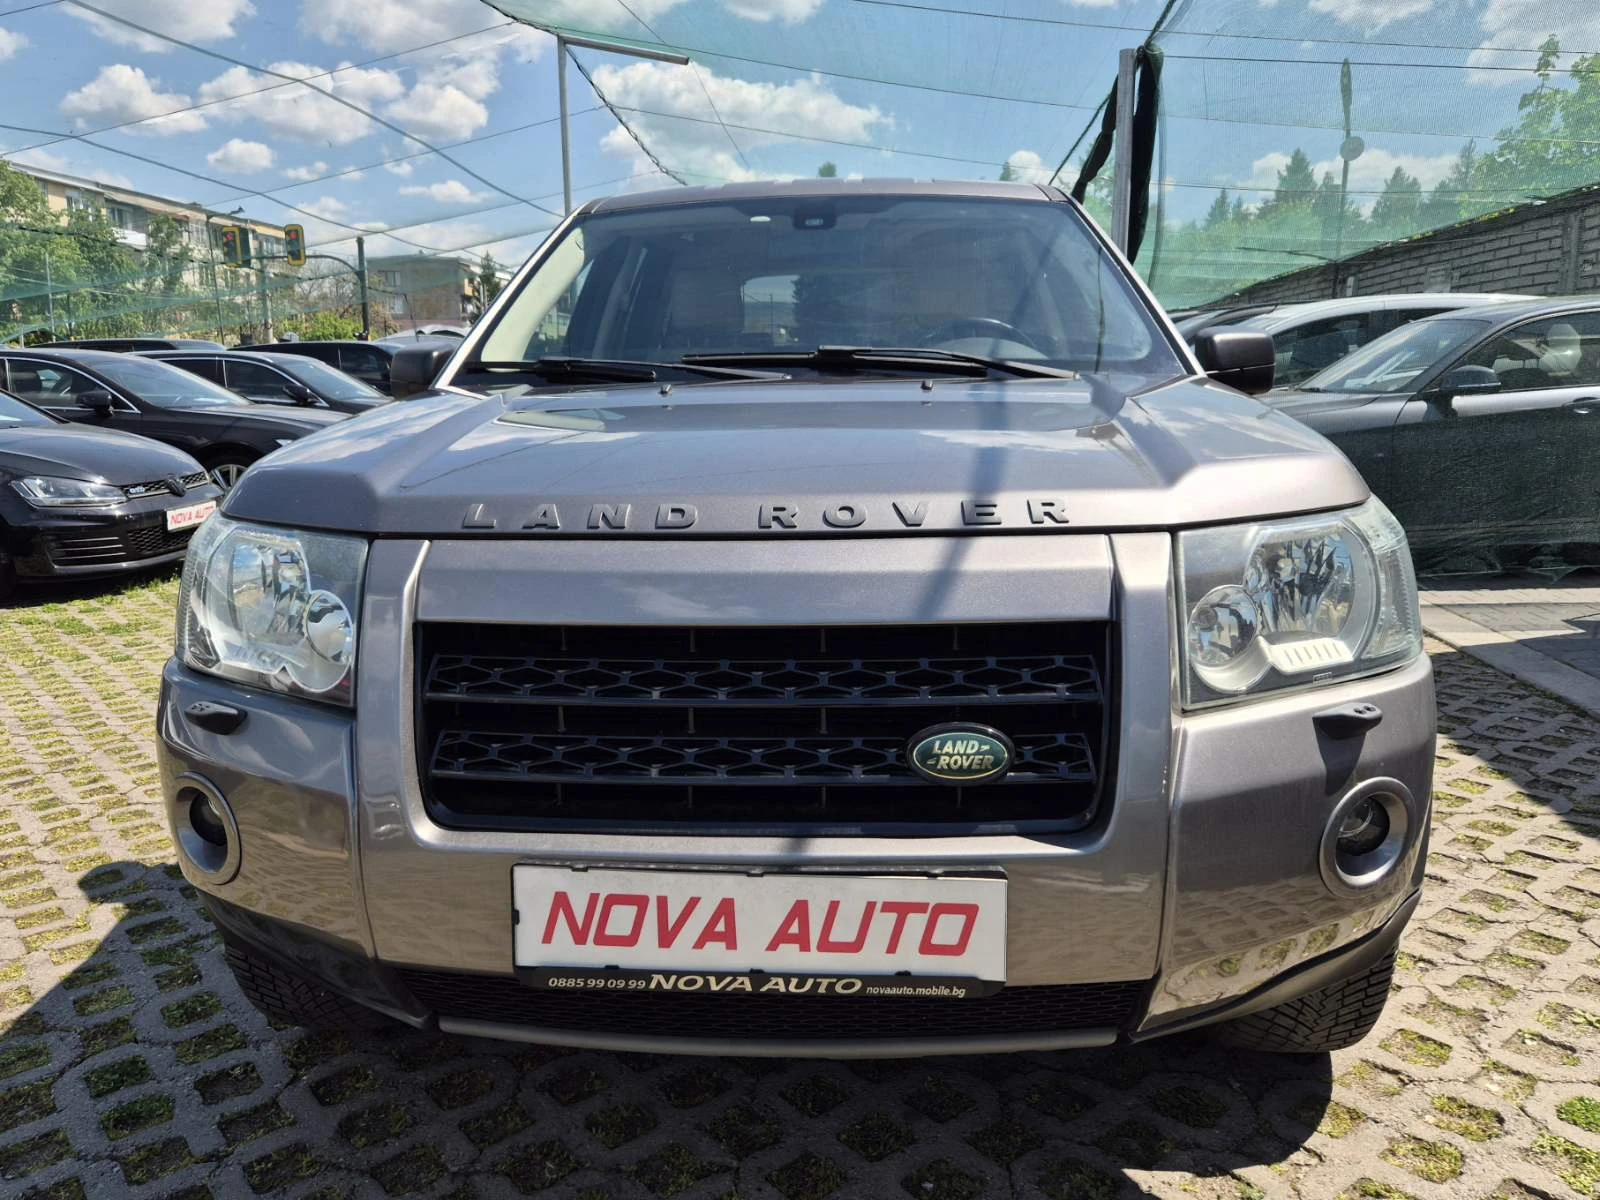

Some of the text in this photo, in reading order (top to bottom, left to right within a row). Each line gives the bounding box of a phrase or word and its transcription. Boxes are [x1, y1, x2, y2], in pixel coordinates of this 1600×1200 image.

[462, 499, 1071, 530] LAND ROVER
[932, 740, 980, 754] LAND
[936, 755, 994, 770] ROVER
[541, 890, 980, 957] NOVA AUTO
[548, 974, 966, 998] 0885 99 09 99 NOVA AUTO novaauto.mobile.bg
